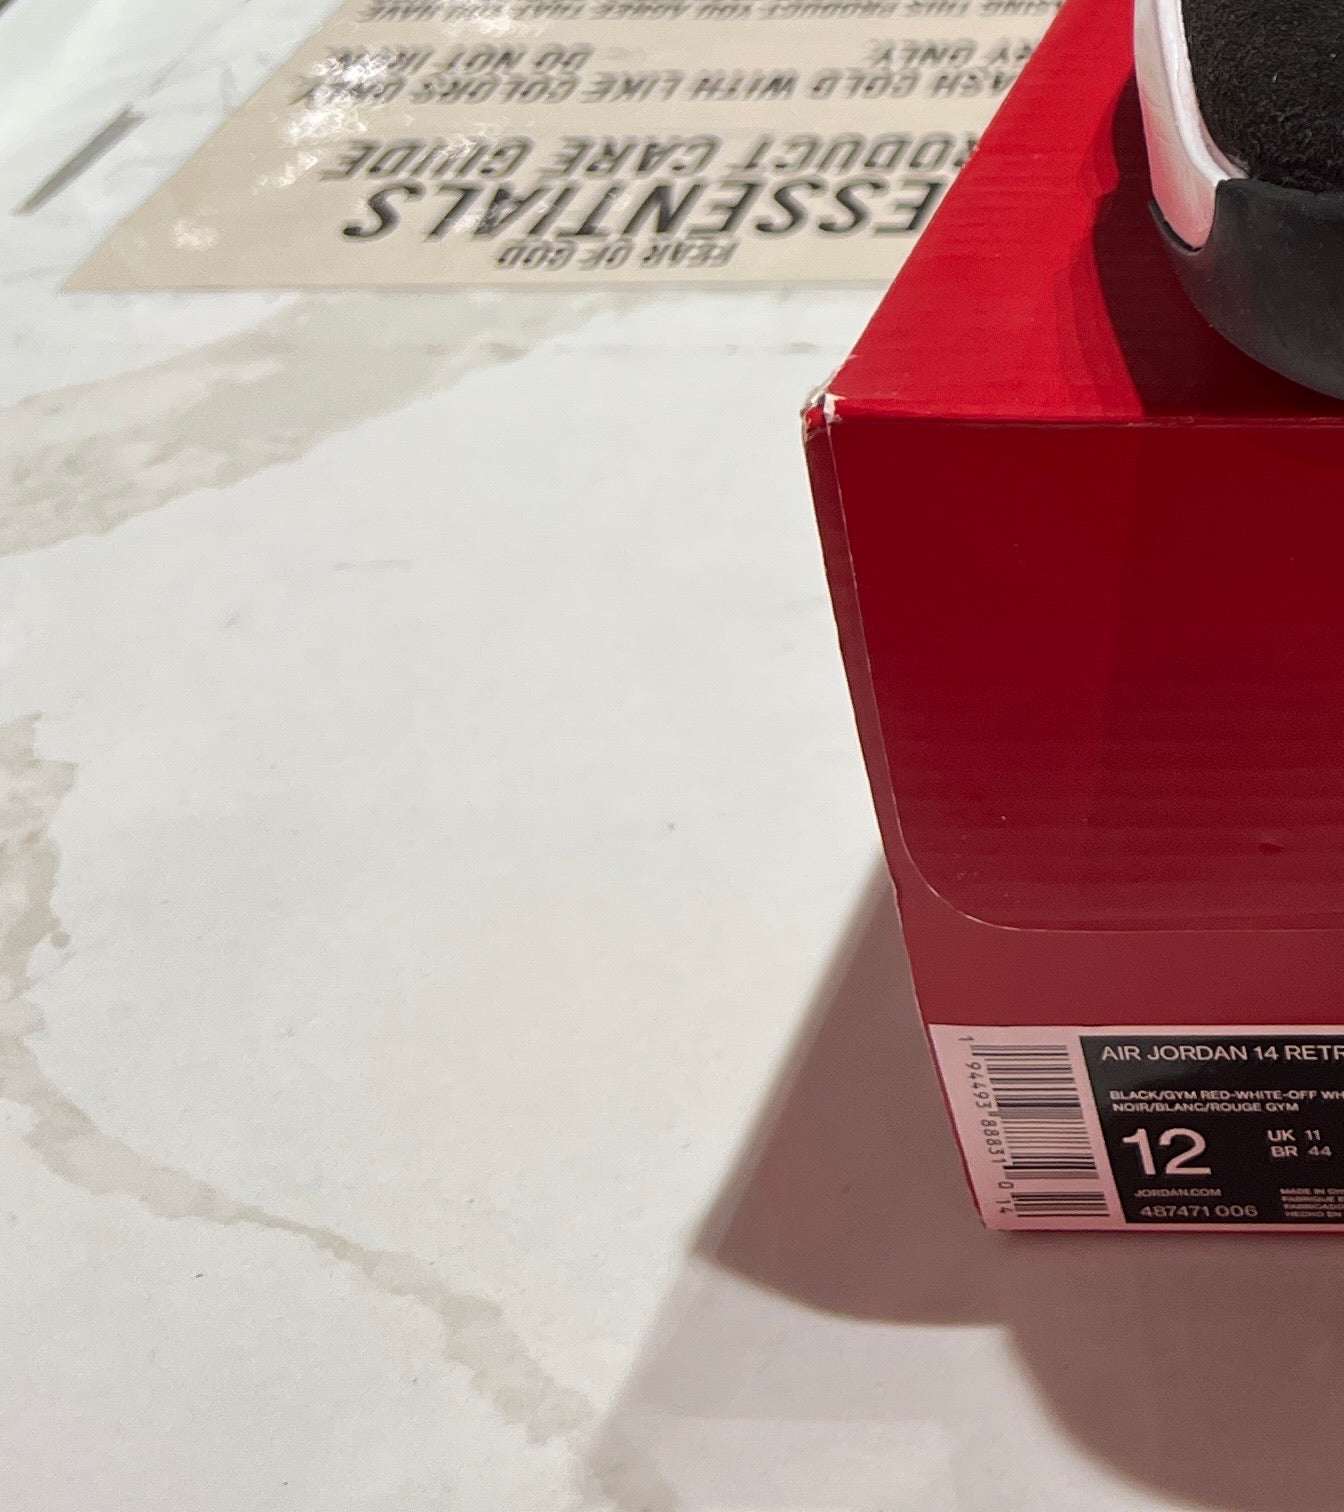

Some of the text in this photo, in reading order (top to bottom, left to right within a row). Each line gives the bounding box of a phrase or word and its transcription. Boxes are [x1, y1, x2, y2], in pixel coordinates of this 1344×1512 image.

[436, 44, 527, 74] NOT
[532, 44, 594, 74] DO
[412, 74, 579, 104] COLORS
[583, 73, 684, 104] LIKE
[690, 70, 797, 101] WITH
[808, 69, 919, 101] COLD
[321, 139, 533, 179] GUIDE
[543, 136, 721, 176] CARE
[342, 178, 949, 240] ESSENTIALS
[492, 241, 740, 270] FEAR OF GOD
[1102, 1045, 1141, 1061] AIR
[1147, 1045, 1248, 1061] JORDAN
[1253, 1045, 1279, 1061] 14
[1109, 1090, 1197, 1100] BLACK/GYM
[1113, 1102, 1299, 1112] NOIR/BLANC/ROUGE GYM
[1267, 1129, 1320, 1141] UK 11
[1122, 1128, 1211, 1176] 12
[1271, 1146, 1332, 1157] BR 44
[1139, 1205, 1258, 1218] 487471 006
